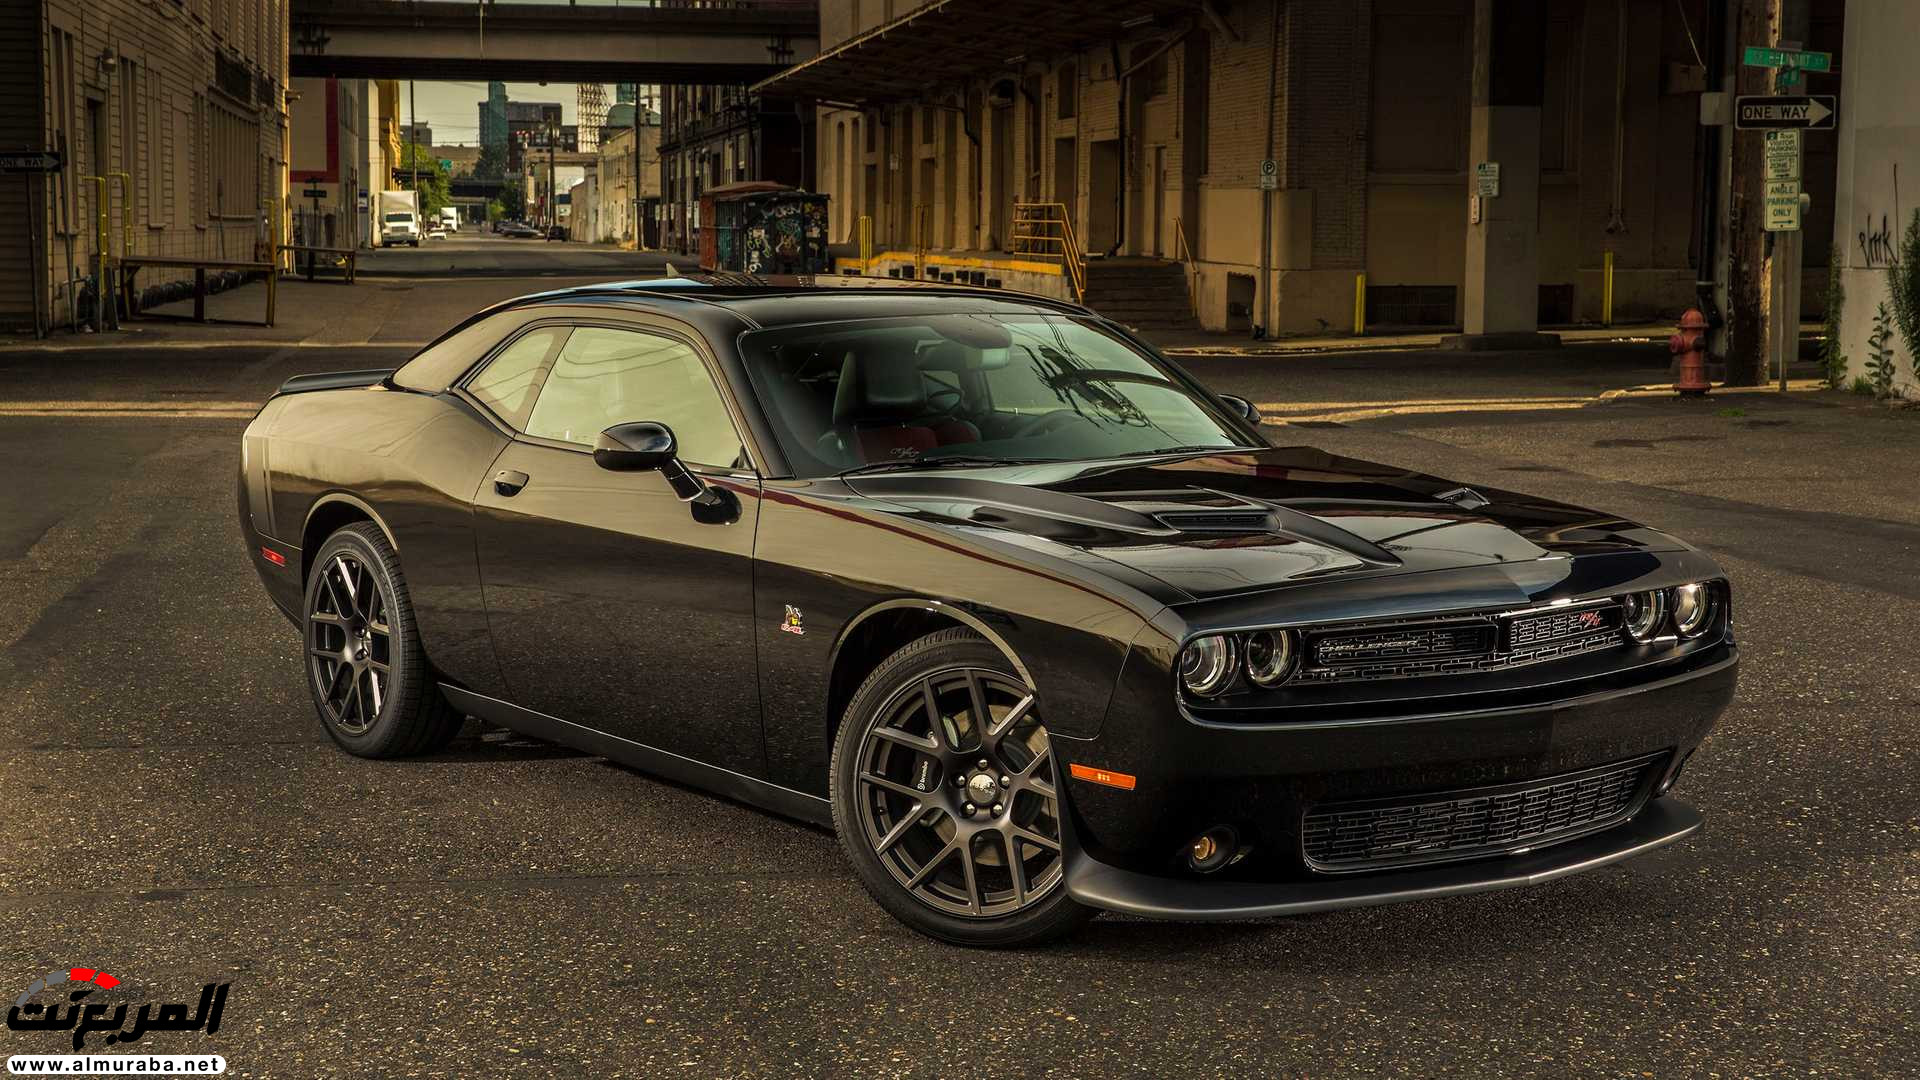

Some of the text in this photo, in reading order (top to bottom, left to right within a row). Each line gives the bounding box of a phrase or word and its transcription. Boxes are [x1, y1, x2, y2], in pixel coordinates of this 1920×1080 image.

[1743, 106, 1809, 119] ONE WAY
[1770, 186, 1793, 194] ANGLE
[1767, 197, 1798, 206] PARKING
[1773, 208, 1792, 217] ONLY
